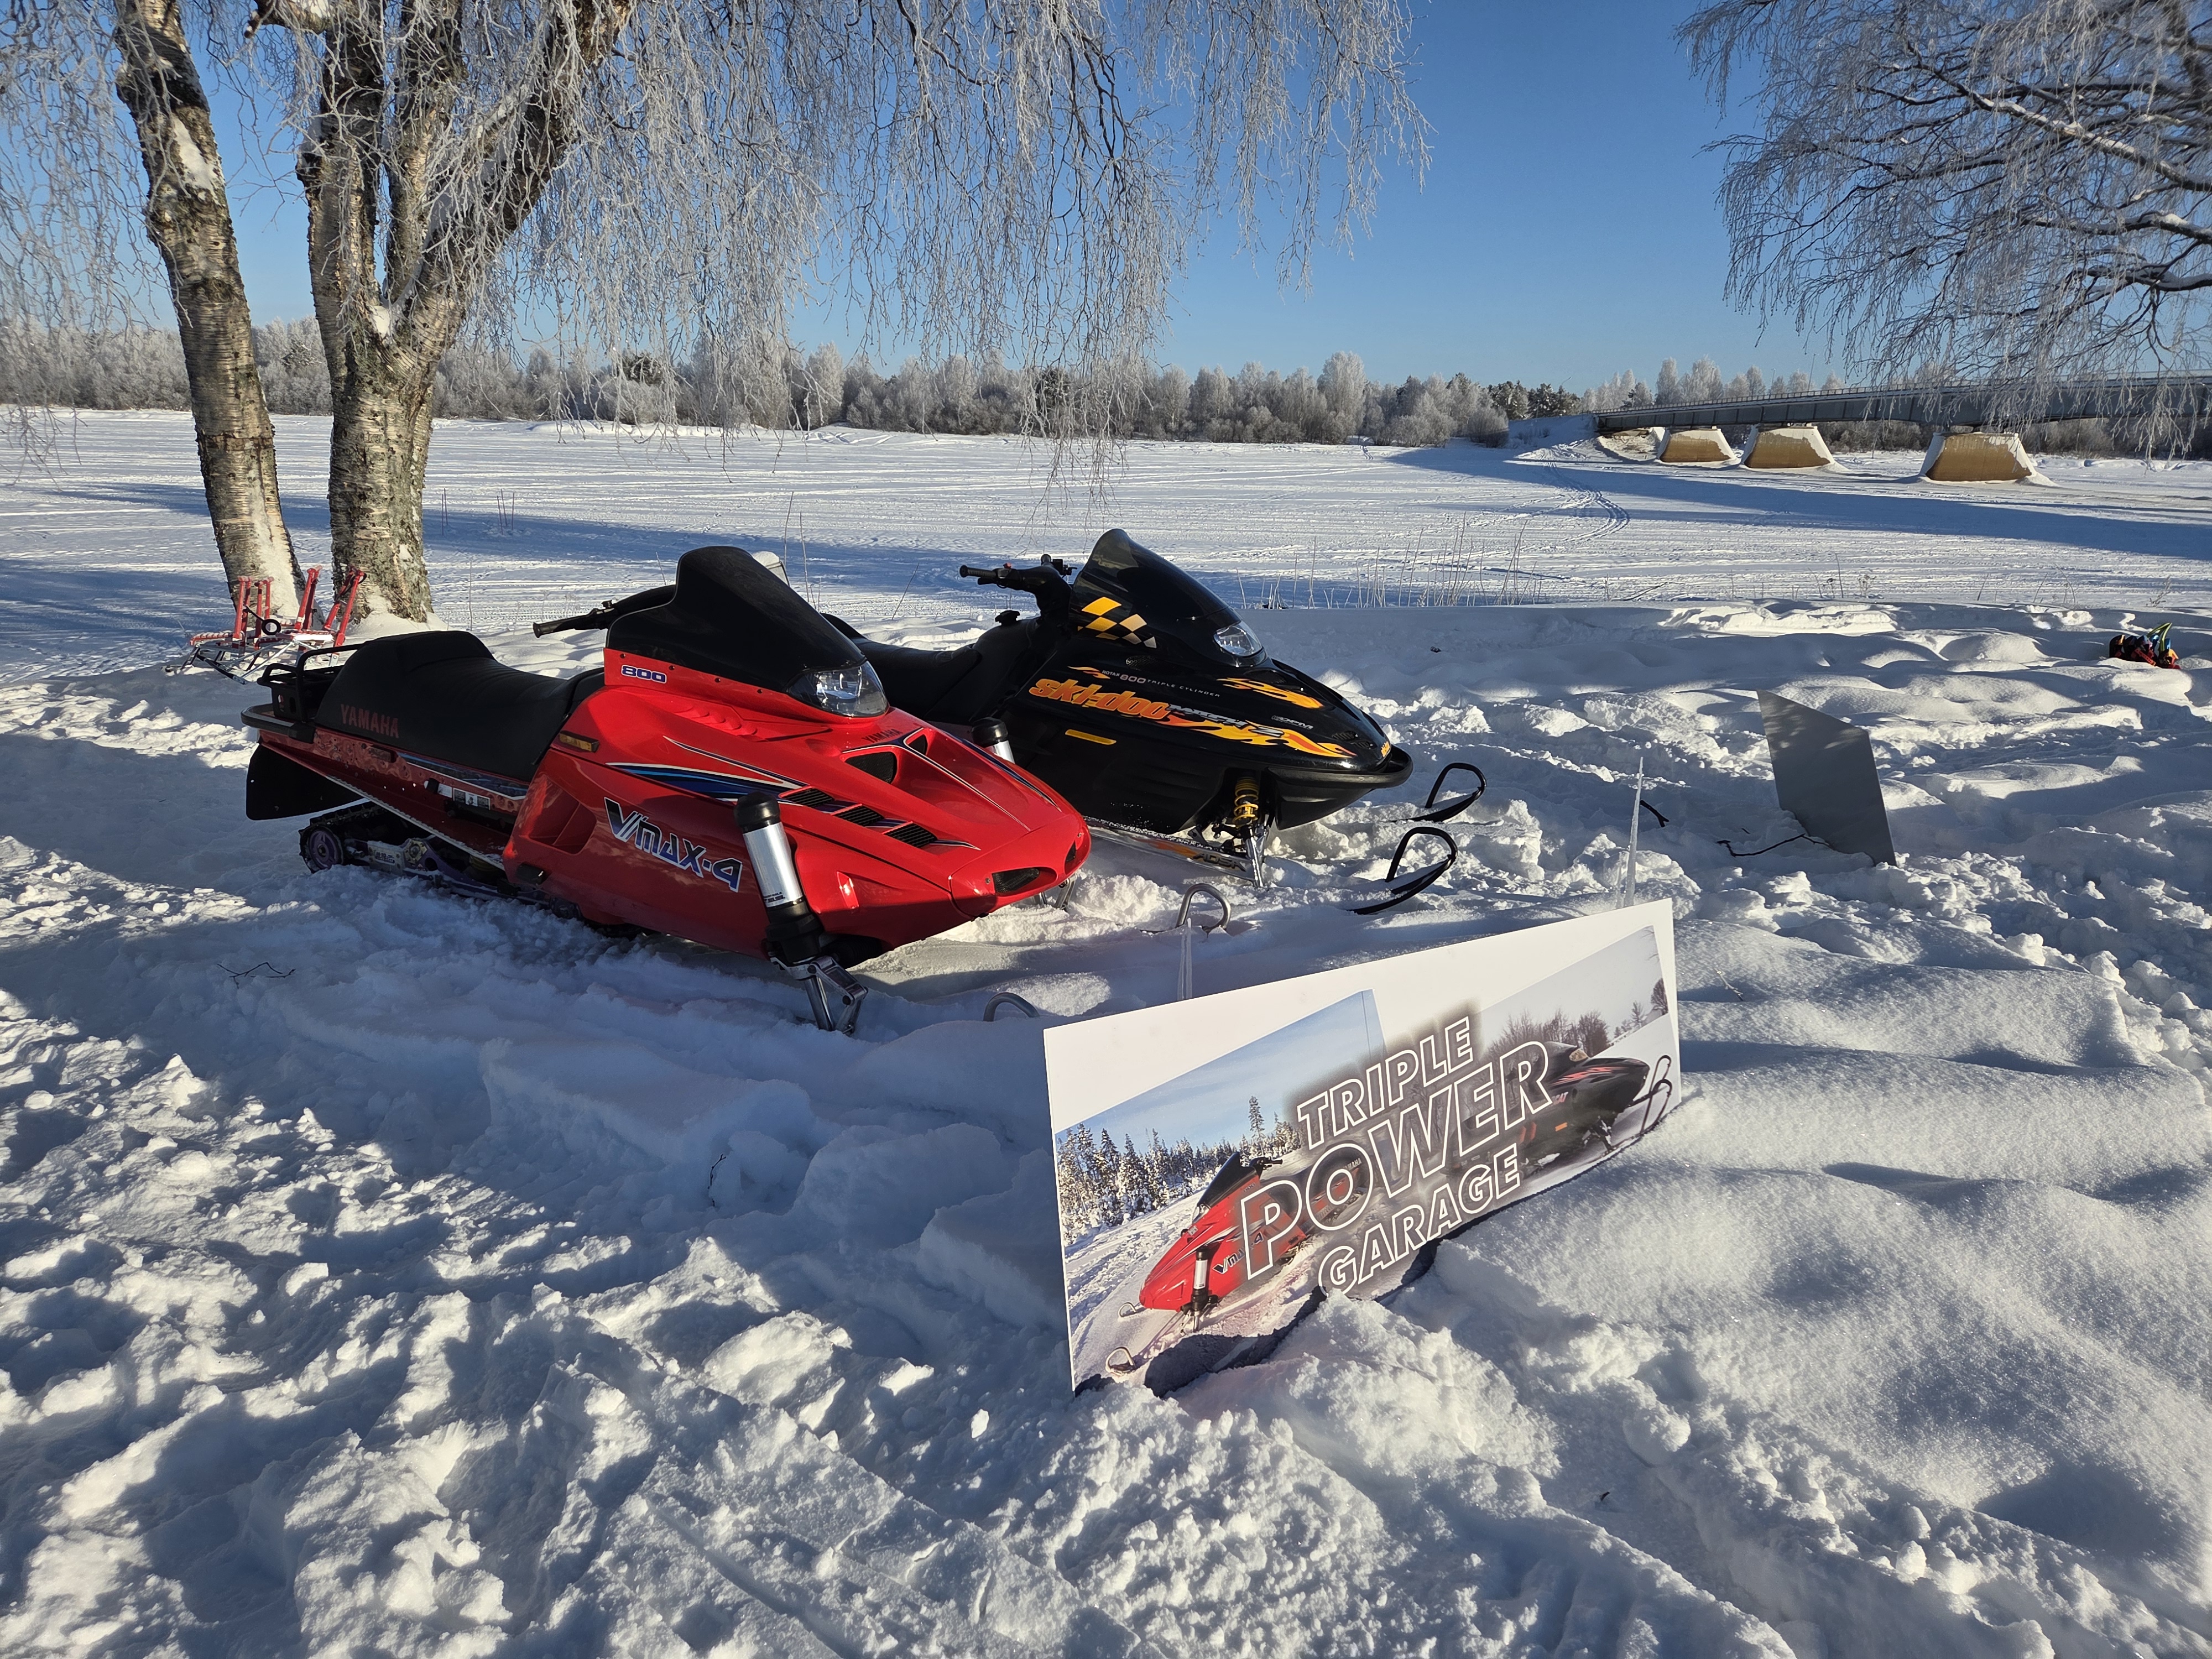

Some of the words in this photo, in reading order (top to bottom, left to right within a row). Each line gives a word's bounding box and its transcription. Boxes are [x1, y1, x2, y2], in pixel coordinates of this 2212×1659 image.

[621, 665, 667, 684] 800
[1119, 674, 1146, 684] 800
[1147, 679, 1176, 688] TRIPLE
[1179, 685, 1220, 697] CYLINDER
[1029, 679, 1172, 719] ski-doo
[341, 703, 399, 738] YAMAHA
[860, 728, 903, 743] YAMAHA
[1297, 1016, 1473, 1150] TRIPLE
[1241, 1041, 1552, 1280] POWER
[1318, 1143, 1520, 1296] GARAGE
